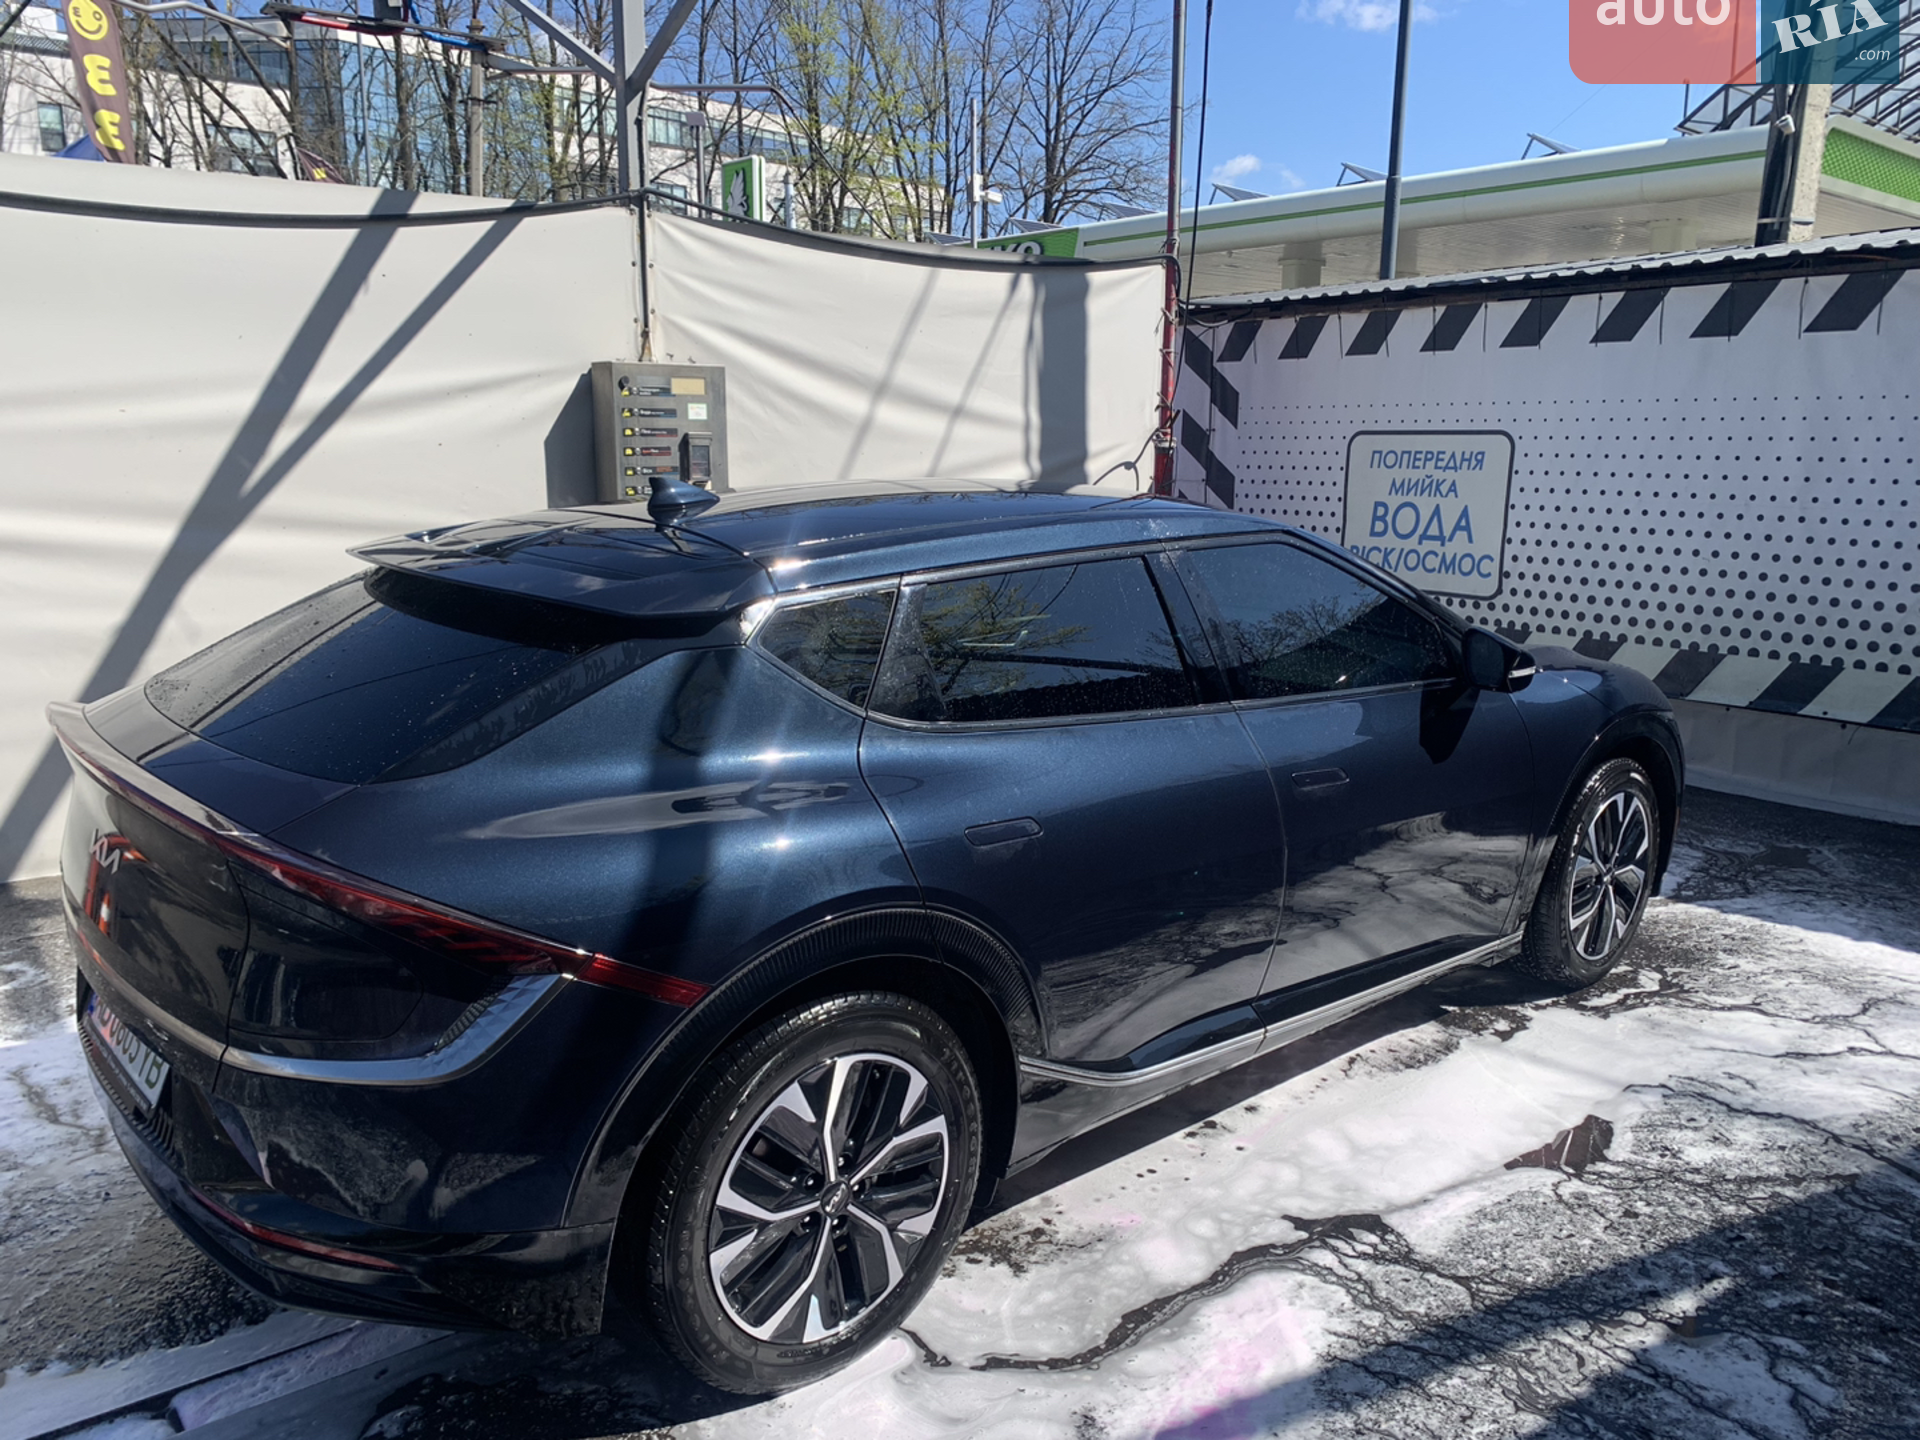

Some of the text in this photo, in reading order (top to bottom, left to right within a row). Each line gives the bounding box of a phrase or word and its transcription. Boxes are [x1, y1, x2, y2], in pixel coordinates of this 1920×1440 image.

[1370, 450, 1486, 473] ПОПЕРЕДНЯ
[1388, 474, 1459, 499] МИЙКА
[1369, 501, 1474, 547] ВОДА
